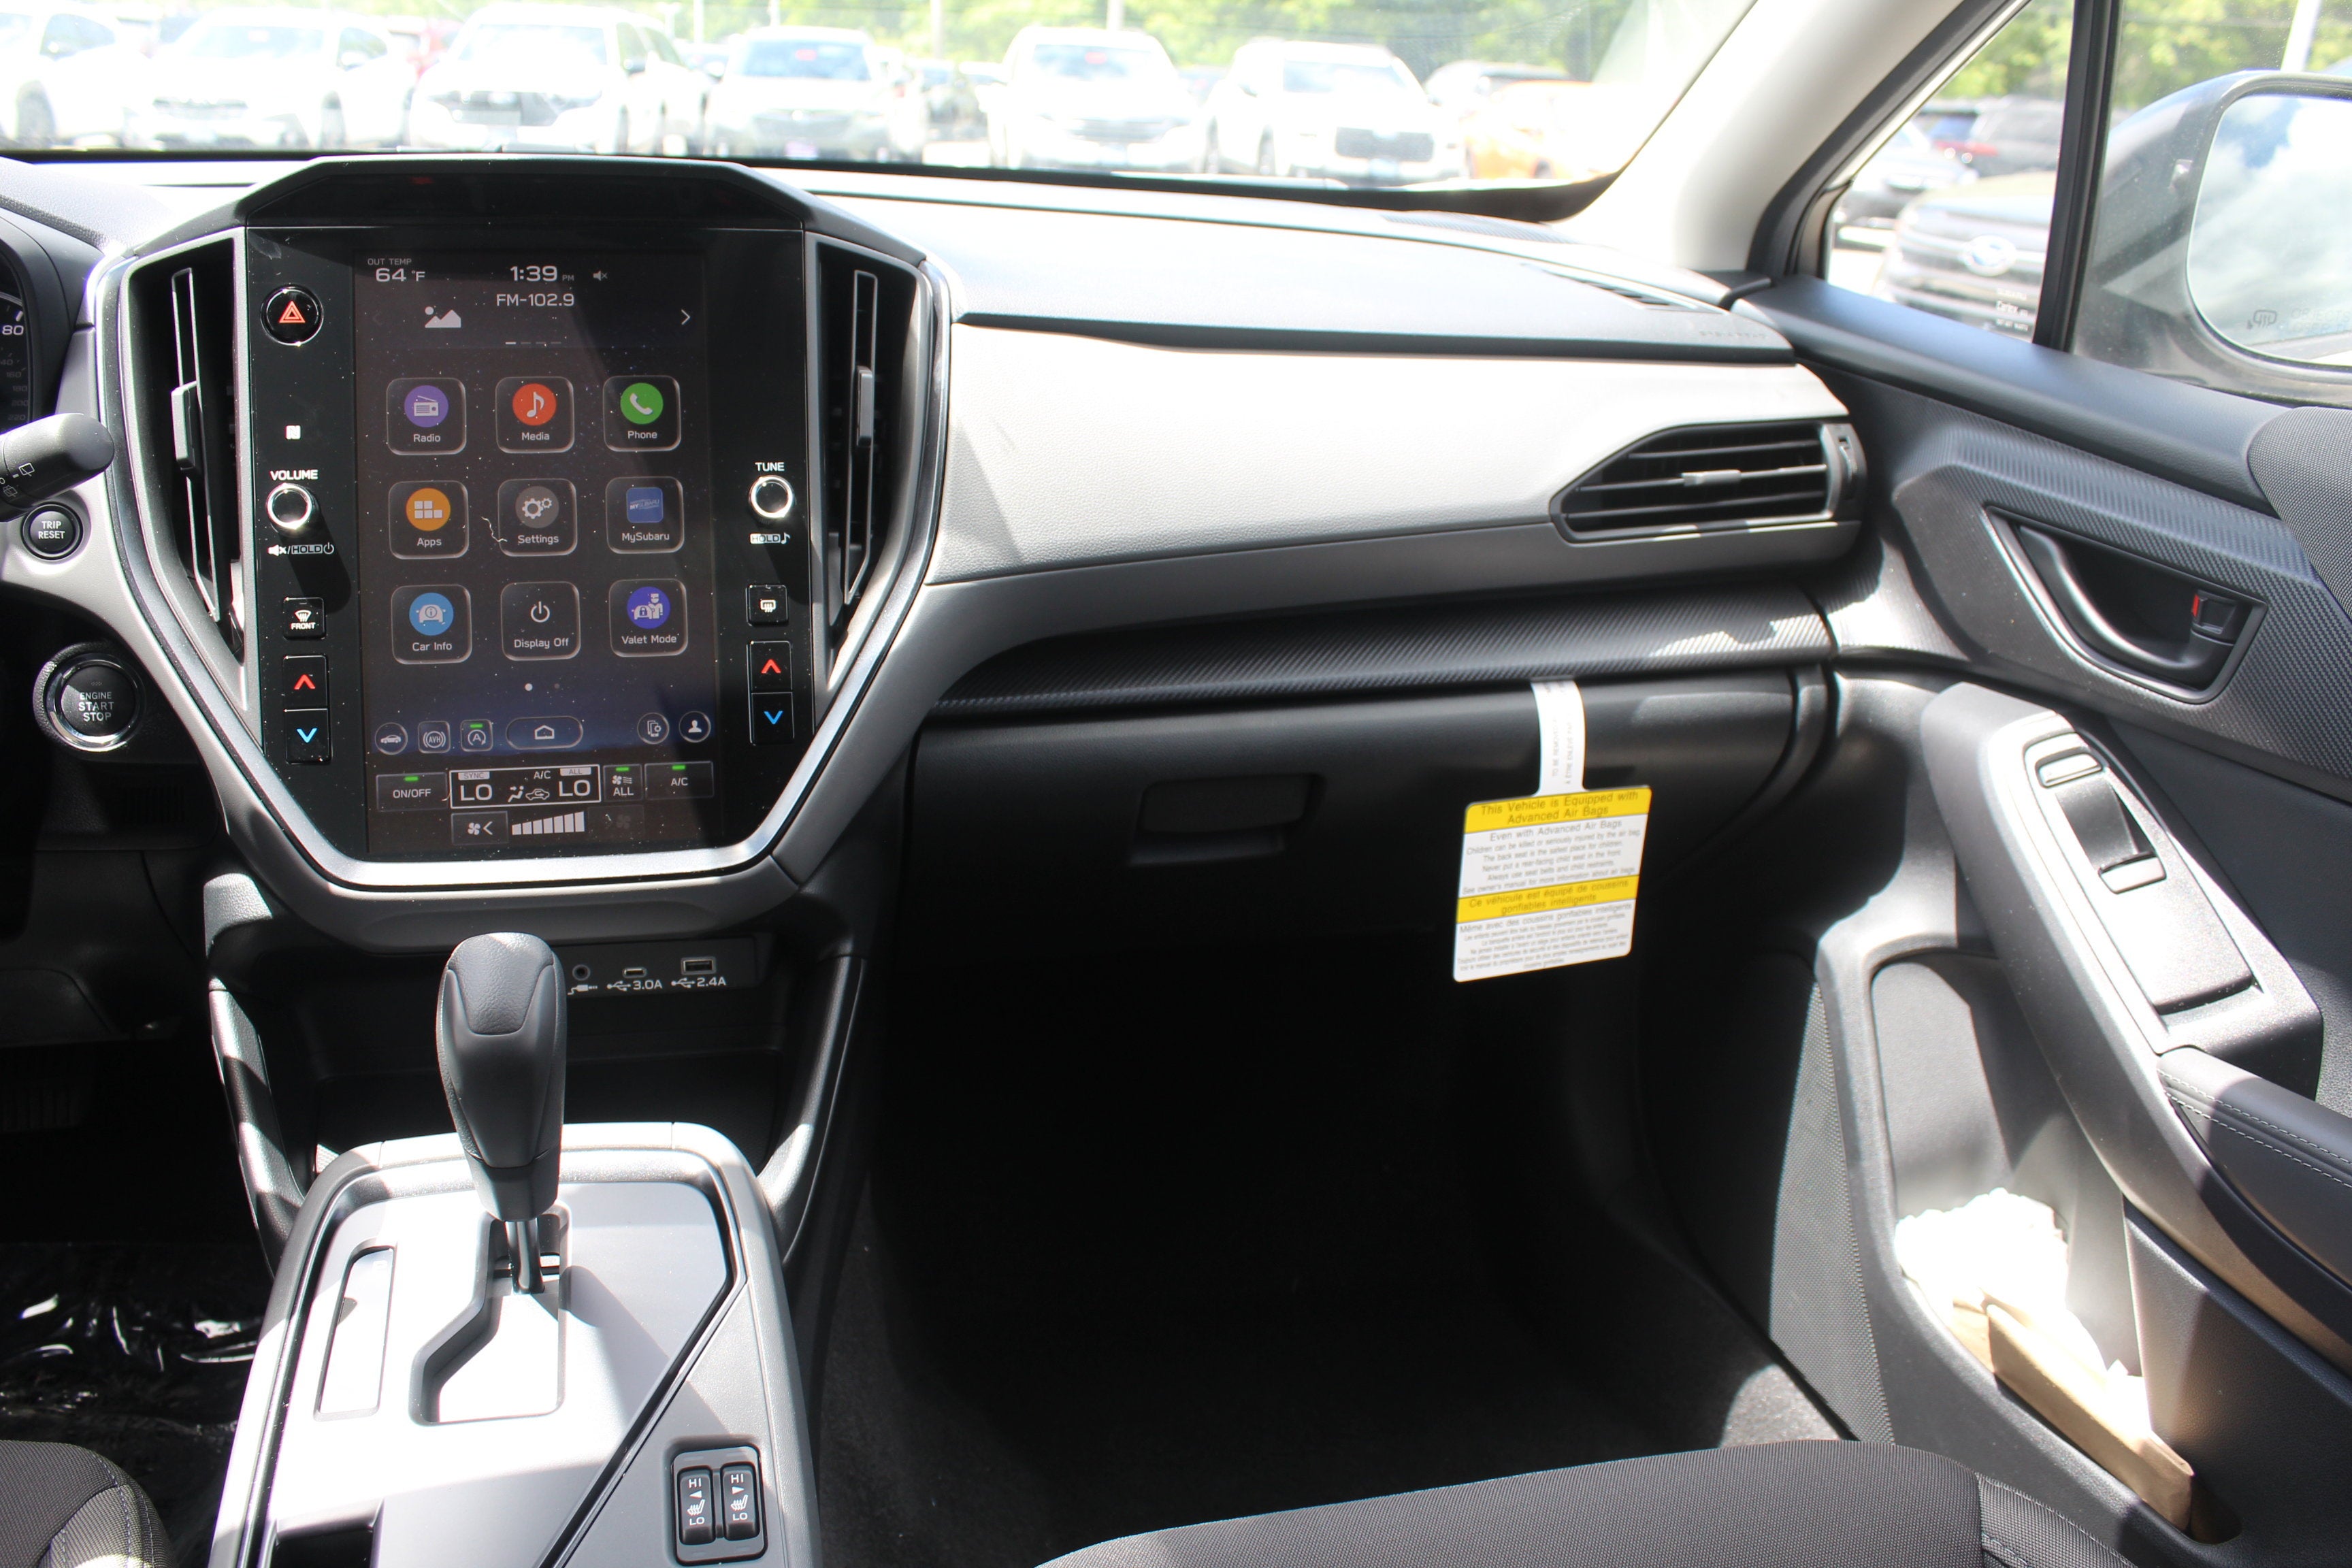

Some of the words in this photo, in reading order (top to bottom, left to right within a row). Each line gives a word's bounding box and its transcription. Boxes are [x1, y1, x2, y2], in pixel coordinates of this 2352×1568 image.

[376, 267, 406, 282] 64
[510, 265, 558, 282] 1:39
[496, 293, 574, 307] FM-102.9
[2, 325, 24, 336] 80
[413, 434, 441, 442] Radio
[521, 432, 550, 441] Media
[627, 430, 657, 439] Phone
[755, 462, 785, 471] TUNE
[270, 470, 318, 480] VOLUME
[42, 521, 62, 529] TRIP
[38, 531, 65, 539] RESET
[517, 534, 559, 545] Settings
[622, 532, 670, 542] MySubaru
[751, 534, 780, 543] HOLD
[416, 538, 442, 547] Apps
[291, 622, 316, 630] FRONT
[514, 638, 550, 649] Display
[553, 638, 569, 647] Off
[621, 635, 647, 644] Valet
[651, 634, 677, 643] Mode
[412, 642, 431, 651] Car
[434, 642, 452, 651] Info
[80, 691, 112, 700] ENGINE
[78, 702, 114, 711] START
[83, 712, 112, 722] STOP
[429, 735, 442, 743] AVH
[534, 770, 551, 779] A/C
[671, 778, 688, 786] A/C
[460, 784, 493, 801] LO
[559, 780, 591, 796] LO
[613, 787, 634, 796] ALL
[393, 789, 431, 798] ON/OFF
[1481, 805, 1503, 815] This
[1507, 800, 1546, 812] Vehicle
[1550, 798, 1558, 807] is
[1564, 792, 1614, 806] Equipped
[1618, 791, 1638, 800] with
[1507, 810, 1560, 825] Advanced
[1563, 808, 1578, 818] Air
[1583, 805, 1608, 817] Bags
[1490, 832, 1512, 842] Even
[1516, 828, 1533, 838] with
[1538, 823, 1581, 835] Advanced
[1584, 821, 1596, 830] Air
[1600, 819, 1622, 830] Bags
[1469, 898, 1482, 908] Ce
[1578, 884, 1588, 894] de
[1592, 880, 1629, 891] coussins
[1550, 894, 1597, 906] intelligents
[632, 979, 662, 990] 3.0A
[696, 977, 726, 987] 2.4A
[689, 1477, 702, 1488] HI
[731, 1473, 744, 1484] HI
[689, 1516, 705, 1526] LO
[732, 1512, 748, 1521] LO
